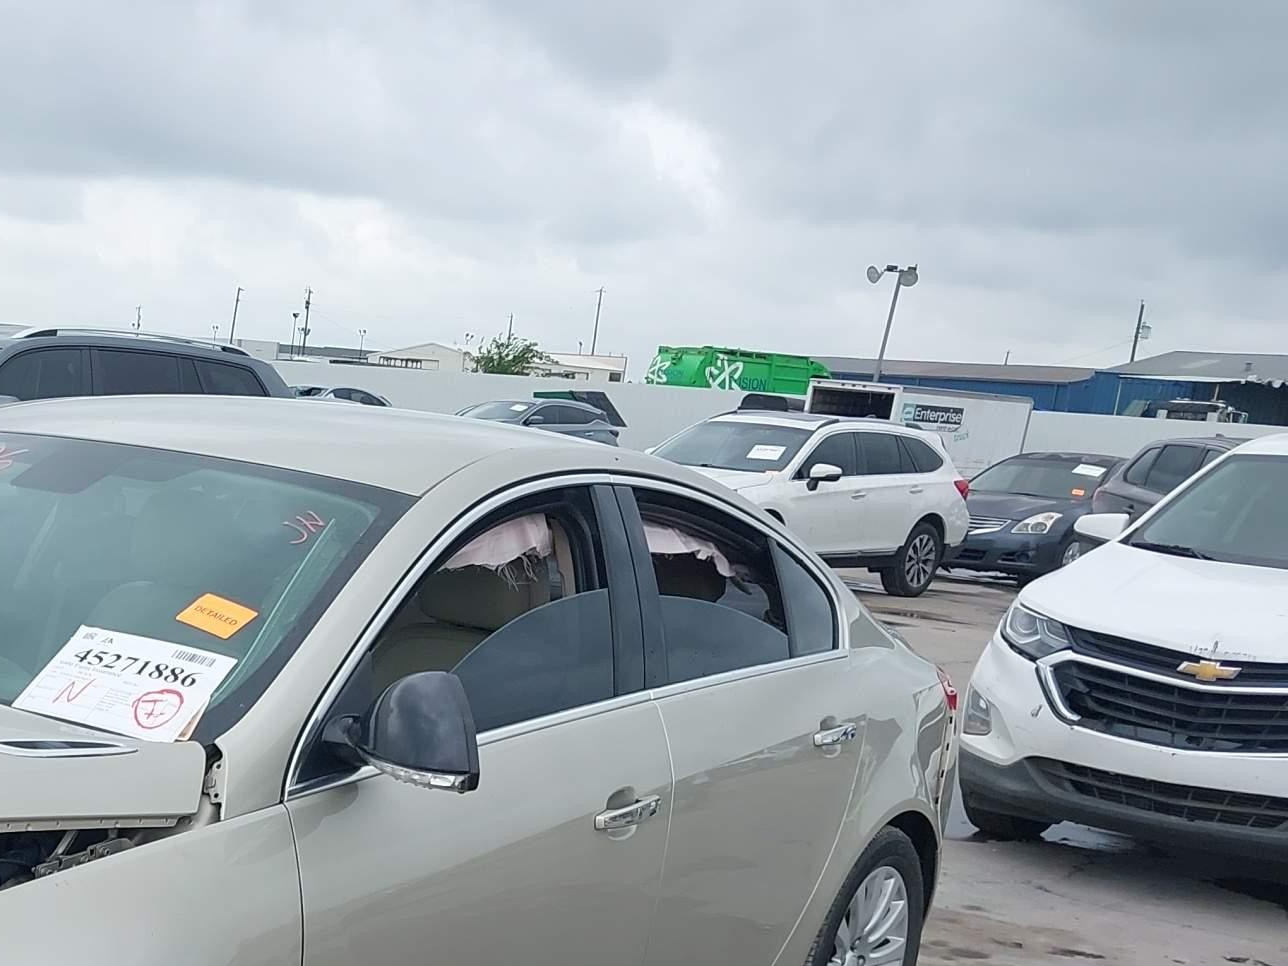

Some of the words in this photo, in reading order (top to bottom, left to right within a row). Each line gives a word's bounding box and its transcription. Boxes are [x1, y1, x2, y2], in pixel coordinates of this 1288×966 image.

[914, 407, 963, 424] Enterprise
[193, 605, 239, 627] DETAILED
[74, 648, 201, 688] 45271886
